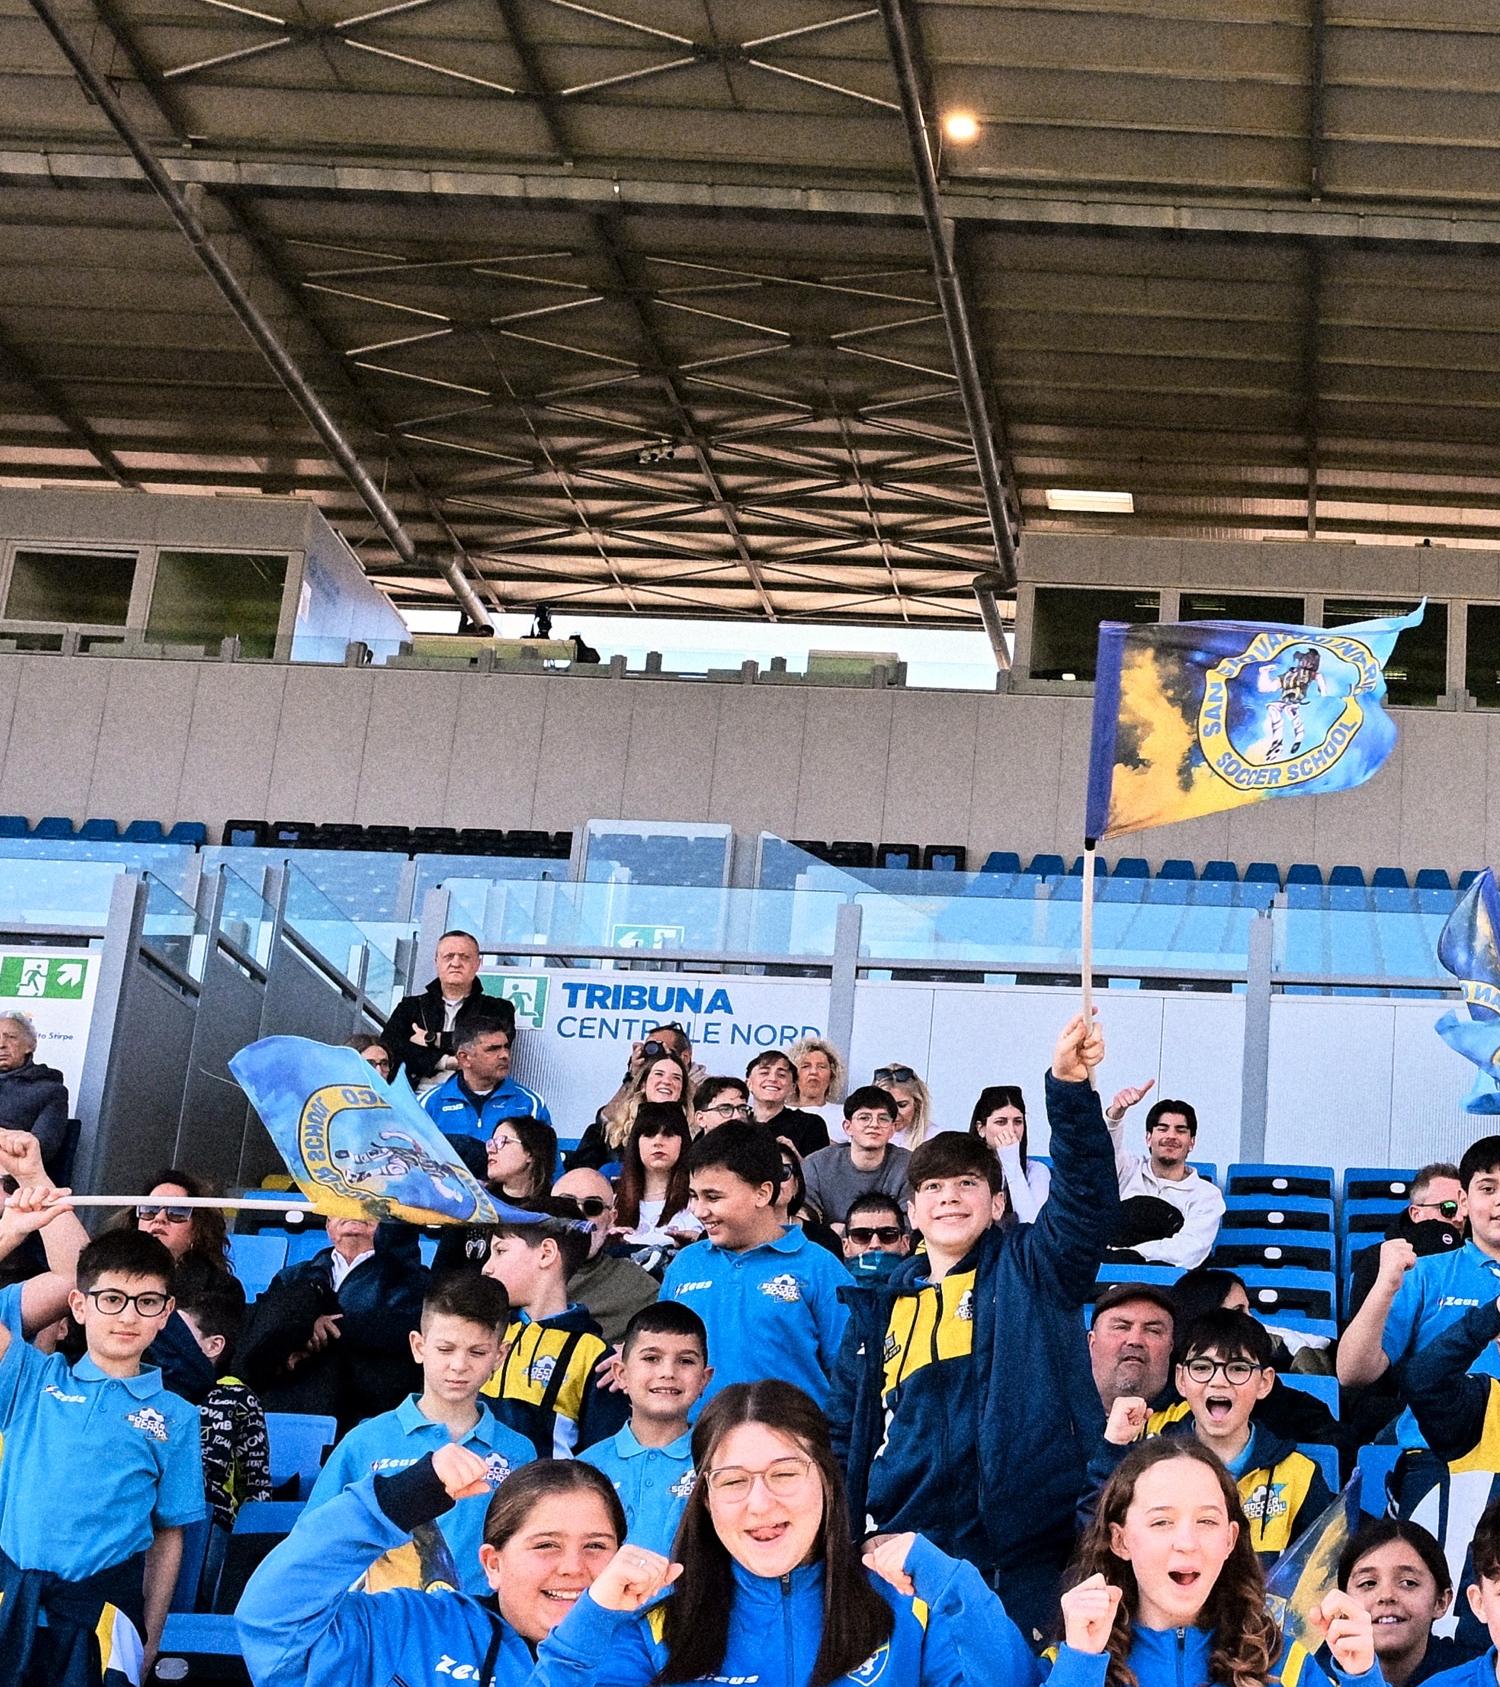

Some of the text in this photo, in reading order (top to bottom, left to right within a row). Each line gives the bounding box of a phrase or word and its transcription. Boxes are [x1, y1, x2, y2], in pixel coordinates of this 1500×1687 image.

[1203, 682, 1224, 737] SAN
[1216, 721, 1358, 785] SOCCER SCHOOL
[562, 982, 734, 1015] TRIBUNA
[557, 1016, 722, 1044] CENTRLE
[1444, 1296, 1479, 1307] Zeus
